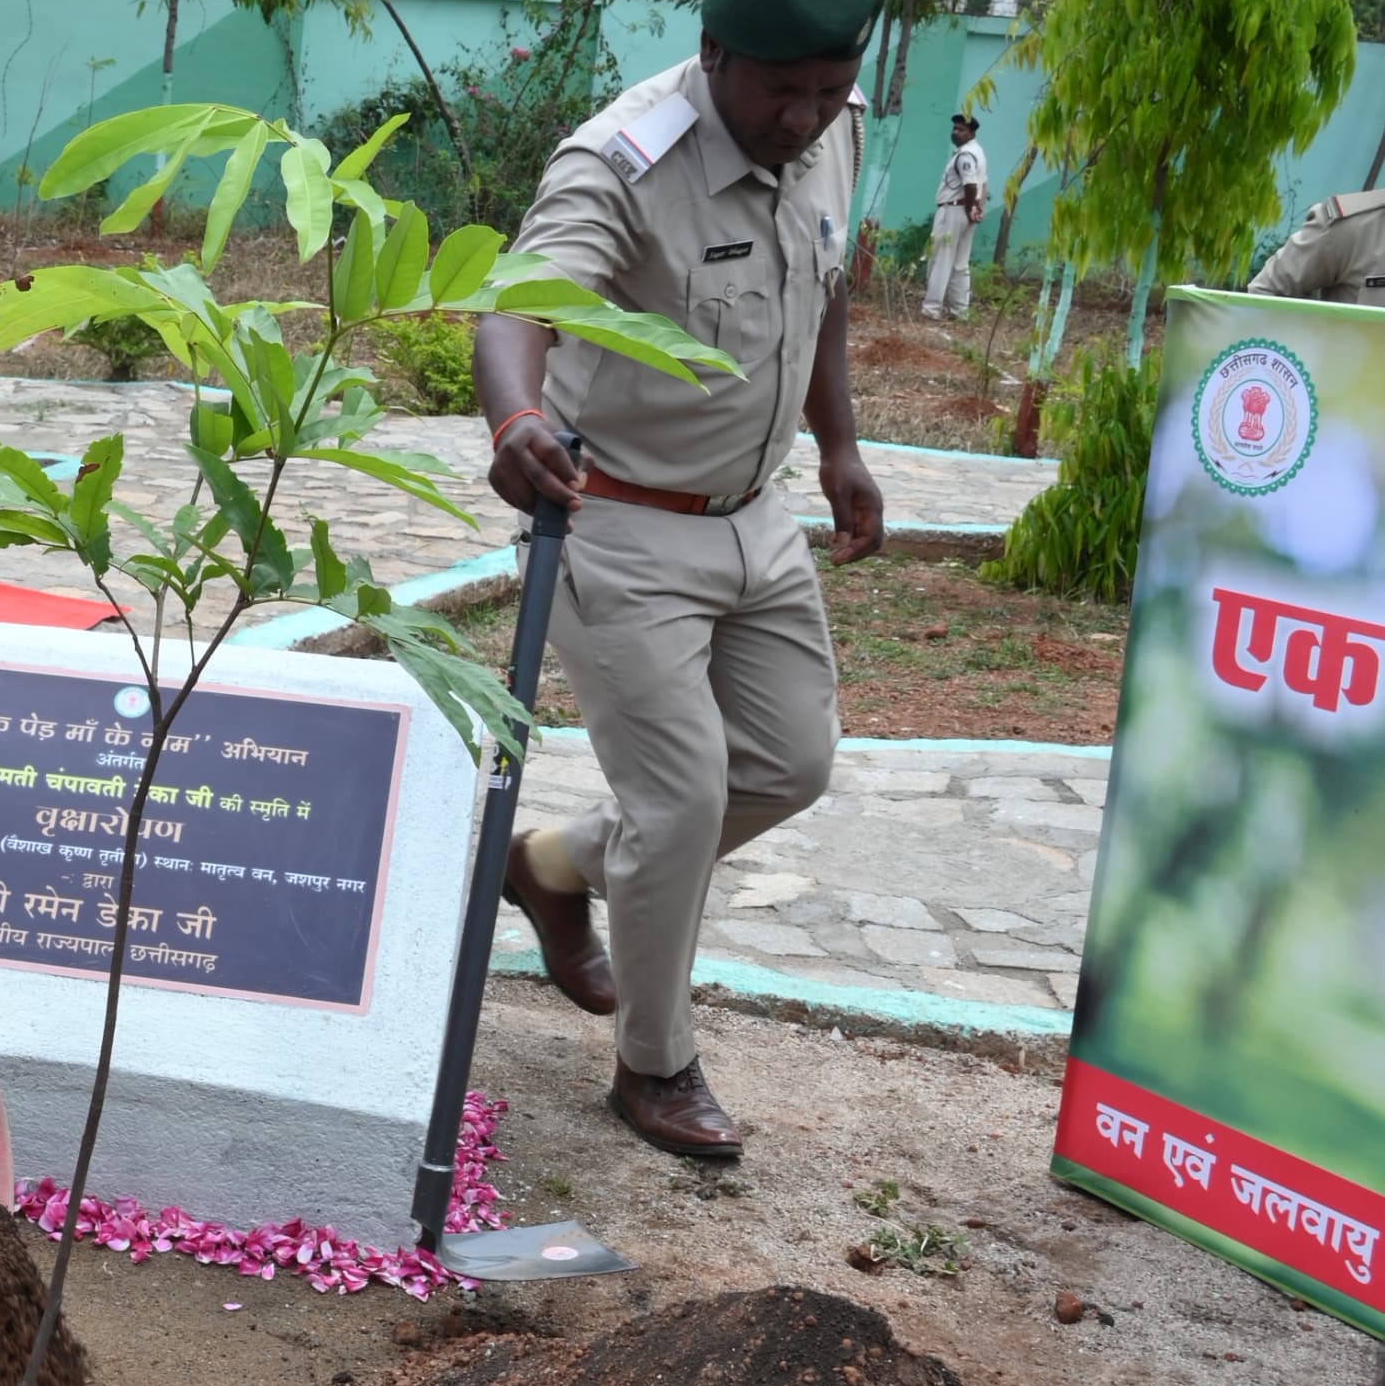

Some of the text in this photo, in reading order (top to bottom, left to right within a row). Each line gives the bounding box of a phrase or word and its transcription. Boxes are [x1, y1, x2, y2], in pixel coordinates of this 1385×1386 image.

[1271, 357, 1298, 389] शासन
[1212, 588, 1385, 713] एक
[20, 712, 58, 741] पेड़
[65, 719, 99, 743] माँ
[104, 722, 133, 746] के
[221, 738, 309, 767] अभियान
[96, 750, 147, 771] अंतर्गत
[45, 767, 127, 799] चंपावती
[185, 785, 214, 810] जी
[218, 793, 245, 814] की
[250, 798, 290, 822] स्मृति
[296, 800, 312, 821] में
[0, 833, 53, 854] (वैशाख
[59, 843, 94, 862] कृष्ण
[200, 860, 246, 882] मातृत्व
[251, 867, 278, 886] वन,
[285, 871, 332, 893] जशपुर
[336, 877, 367, 894] नगर
[81, 872, 115, 890] द्वारा
[24, 885, 84, 924] रमेन
[95, 892, 164, 934] डेका
[176, 905, 218, 941] जी
[129, 942, 219, 974] छत्तीसगढ़
[1095, 1101, 1381, 1284] वन एवं जलवायु
